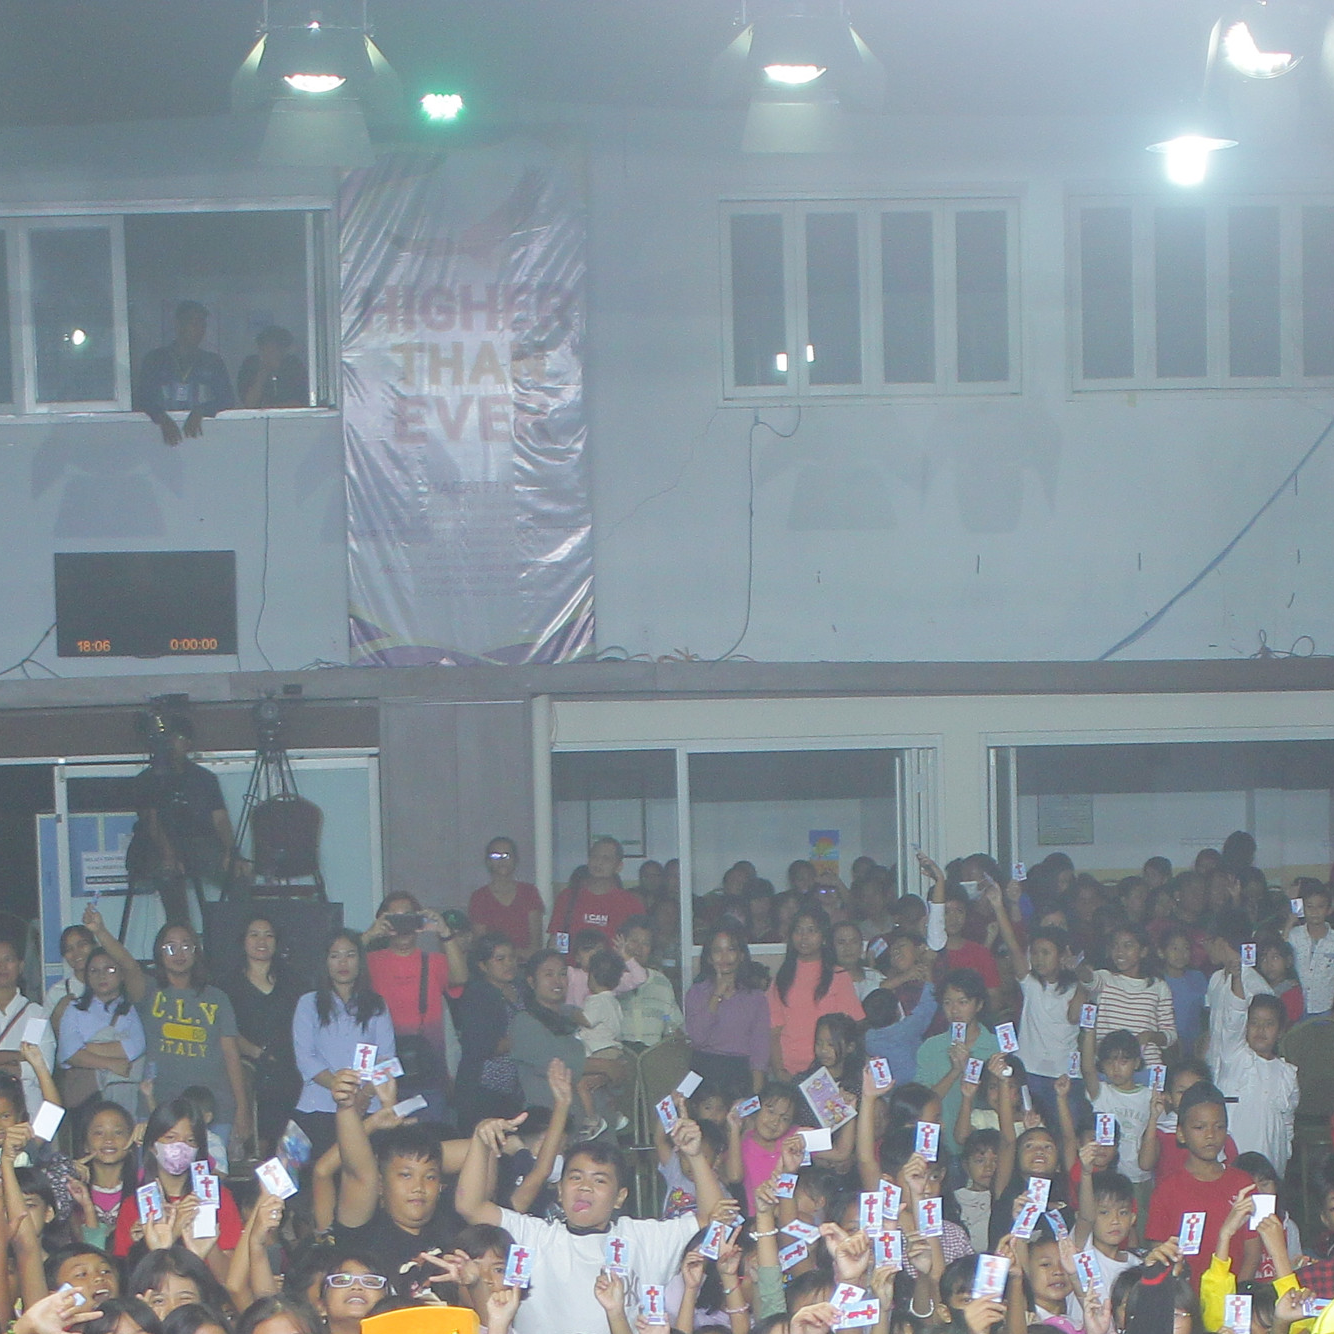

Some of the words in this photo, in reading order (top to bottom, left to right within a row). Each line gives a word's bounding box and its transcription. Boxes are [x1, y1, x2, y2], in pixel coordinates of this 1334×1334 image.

[394, 395, 515, 443] EVE
[78, 640, 112, 652] 18:06
[170, 638, 219, 651] 0:00:00
[159, 1038, 208, 1058] ITALY
